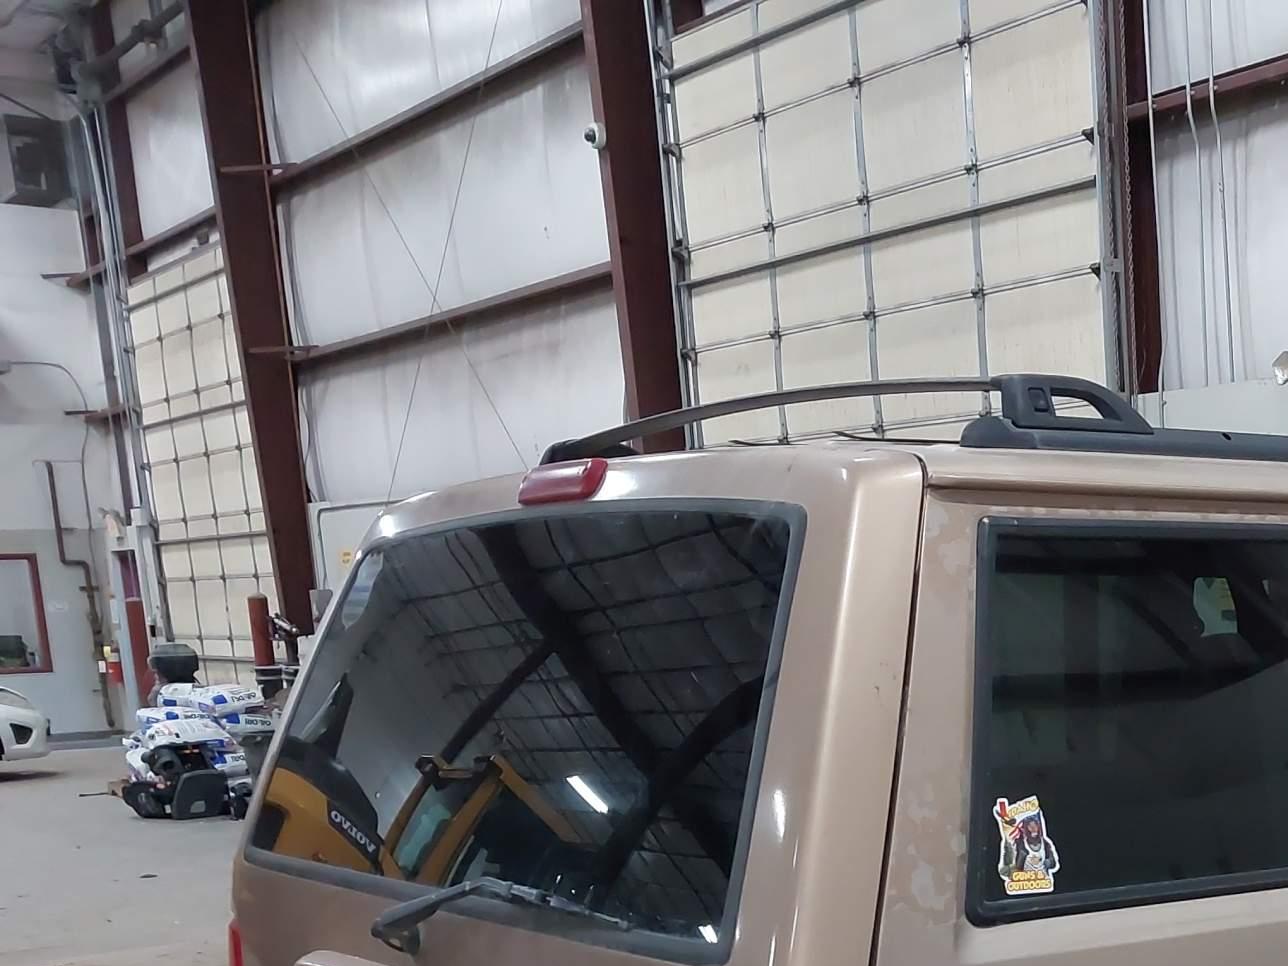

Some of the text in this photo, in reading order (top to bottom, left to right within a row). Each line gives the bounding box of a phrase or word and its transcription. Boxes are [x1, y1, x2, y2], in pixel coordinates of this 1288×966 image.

[1012, 870, 1045, 881] GUNS &
[1008, 879, 1051, 891] OUTDOORS
